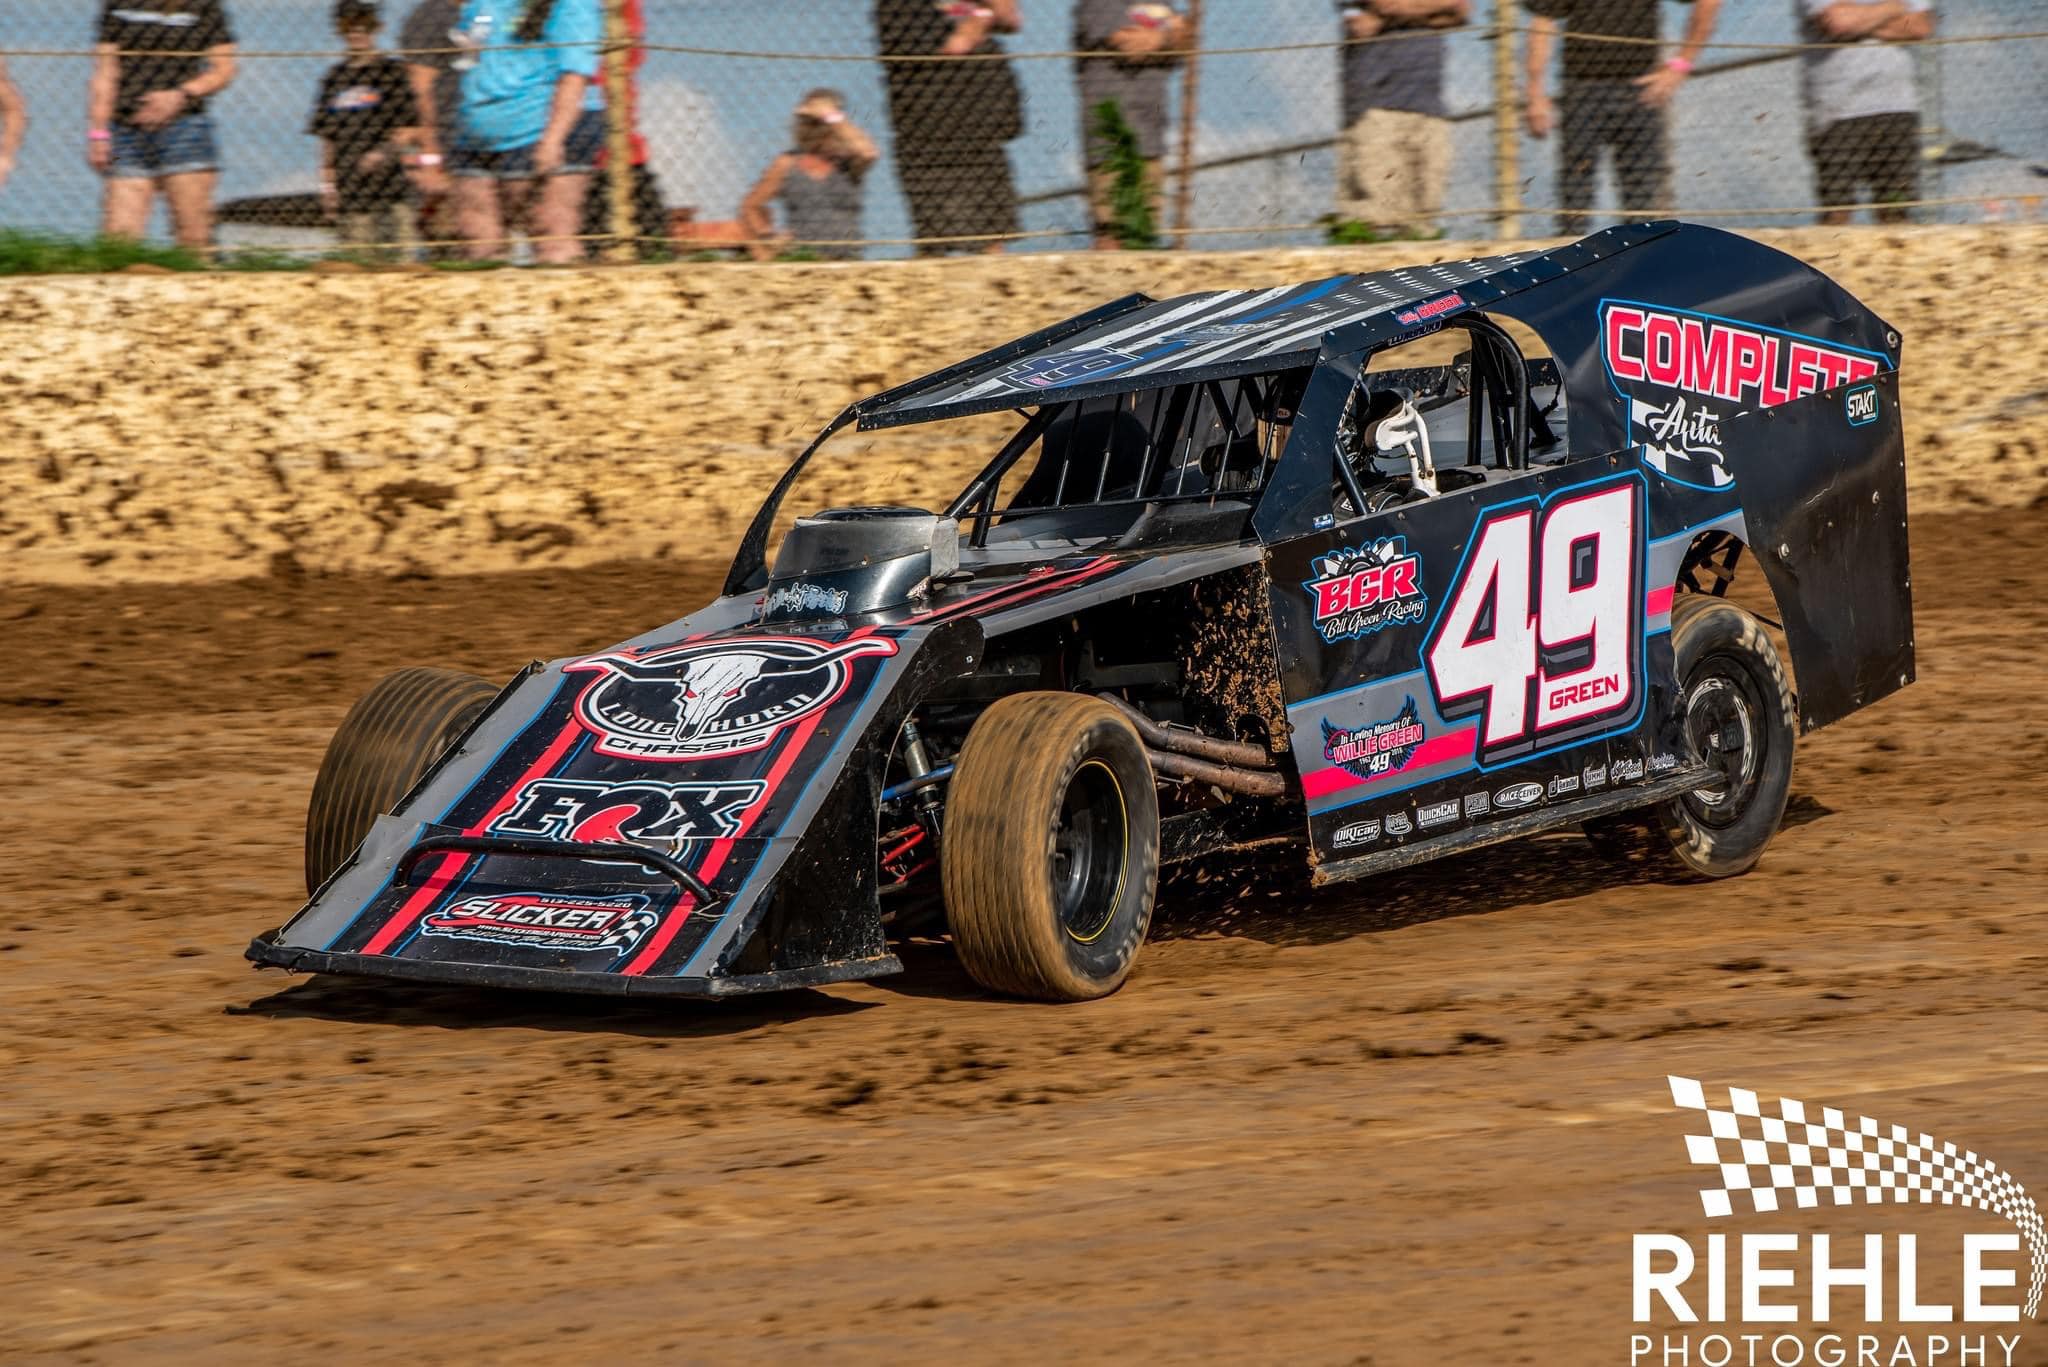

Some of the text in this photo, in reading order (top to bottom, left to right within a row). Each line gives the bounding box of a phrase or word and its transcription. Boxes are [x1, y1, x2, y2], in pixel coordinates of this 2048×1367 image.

[1310, 557, 1419, 620] BGR
[1323, 600, 1424, 638] Bill Green Racing
[1430, 483, 1633, 747] 49
[1549, 674, 1620, 711] GREEN
[604, 732, 767, 755] CHASSIS
[1333, 723, 1423, 764] WILLIE GREEN
[1350, 728, 1373, 742] Loving
[1374, 720, 1400, 735] Memory
[1370, 751, 1391, 773] 49
[490, 780, 766, 845] FOX
[452, 900, 617, 929] SLICKER
